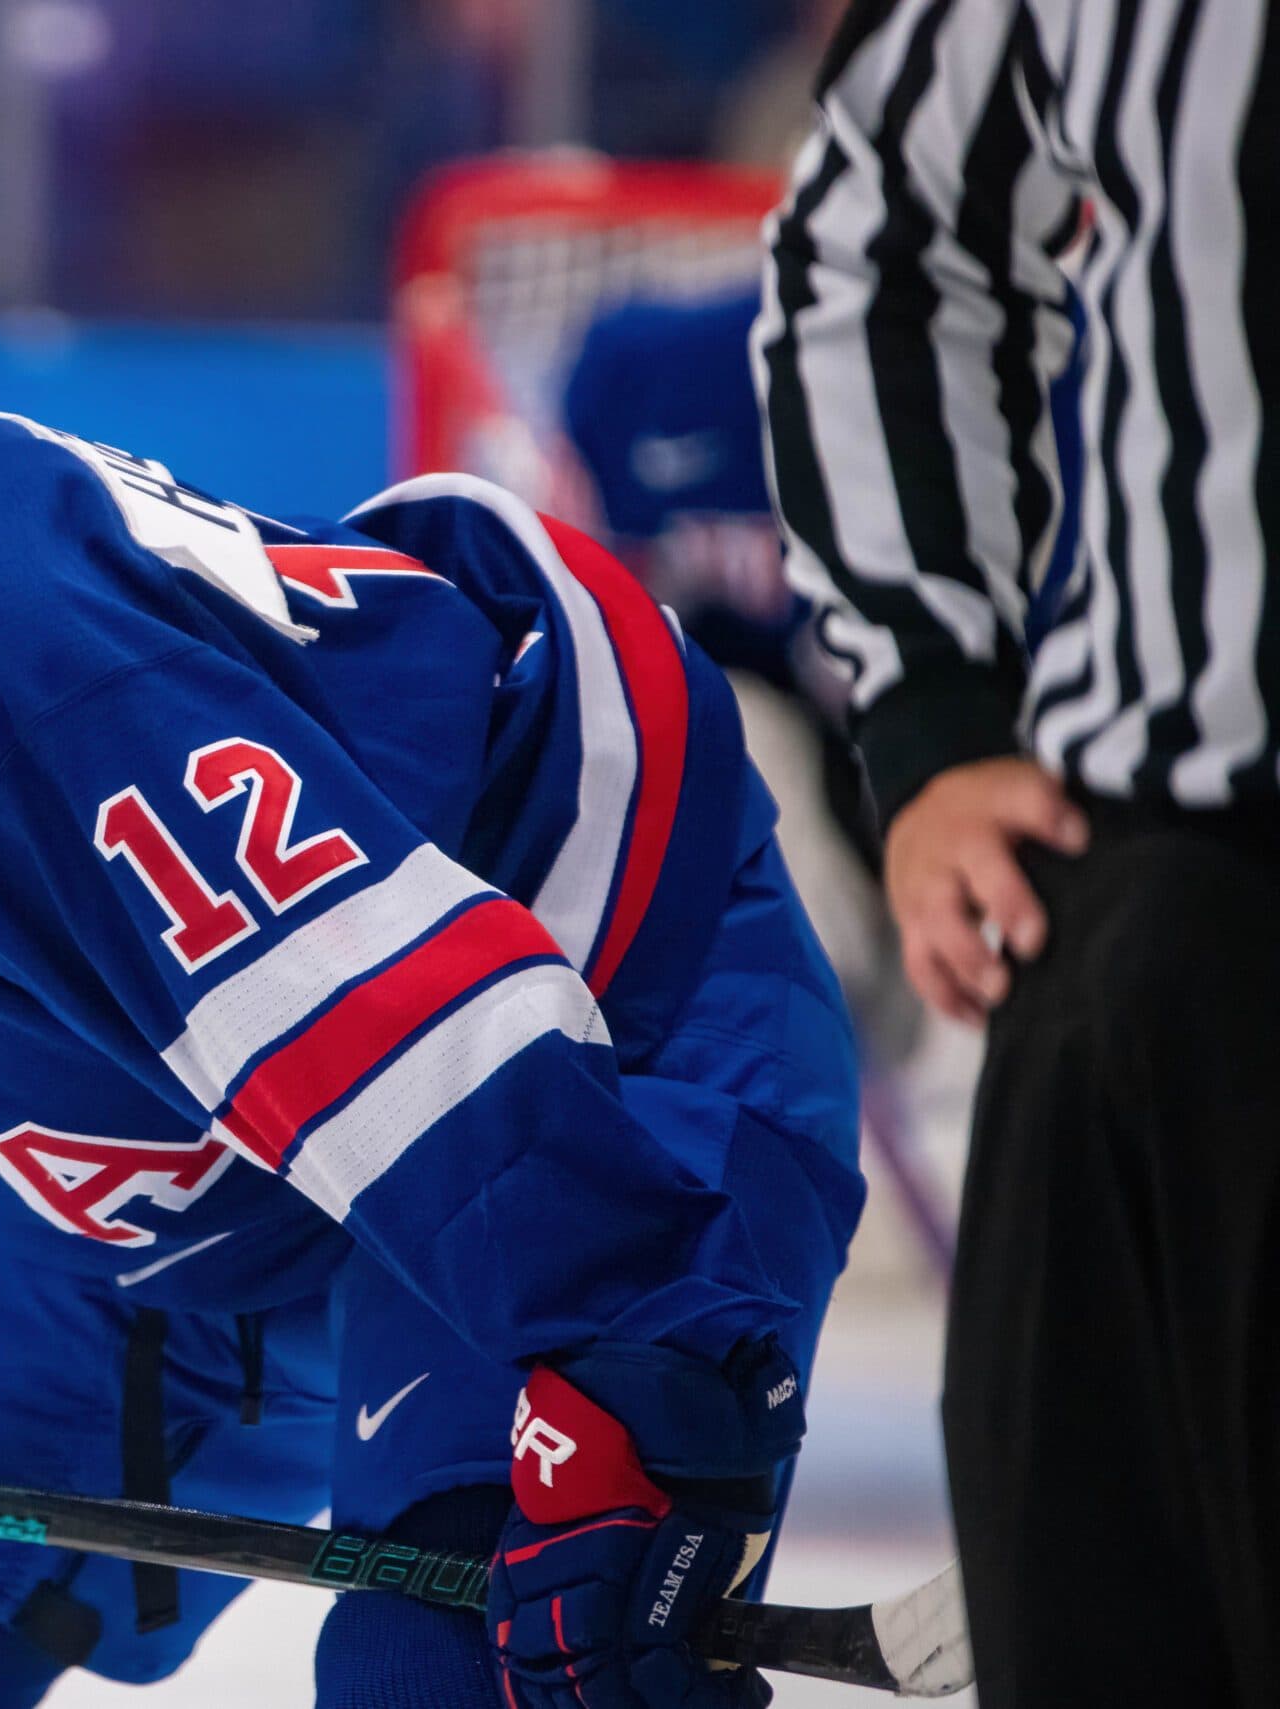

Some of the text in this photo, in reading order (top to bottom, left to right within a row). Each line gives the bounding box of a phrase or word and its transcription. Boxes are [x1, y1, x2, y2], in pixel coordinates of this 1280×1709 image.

[93, 737, 370, 976] 12
[648, 1534, 704, 1628] TEAM USA
